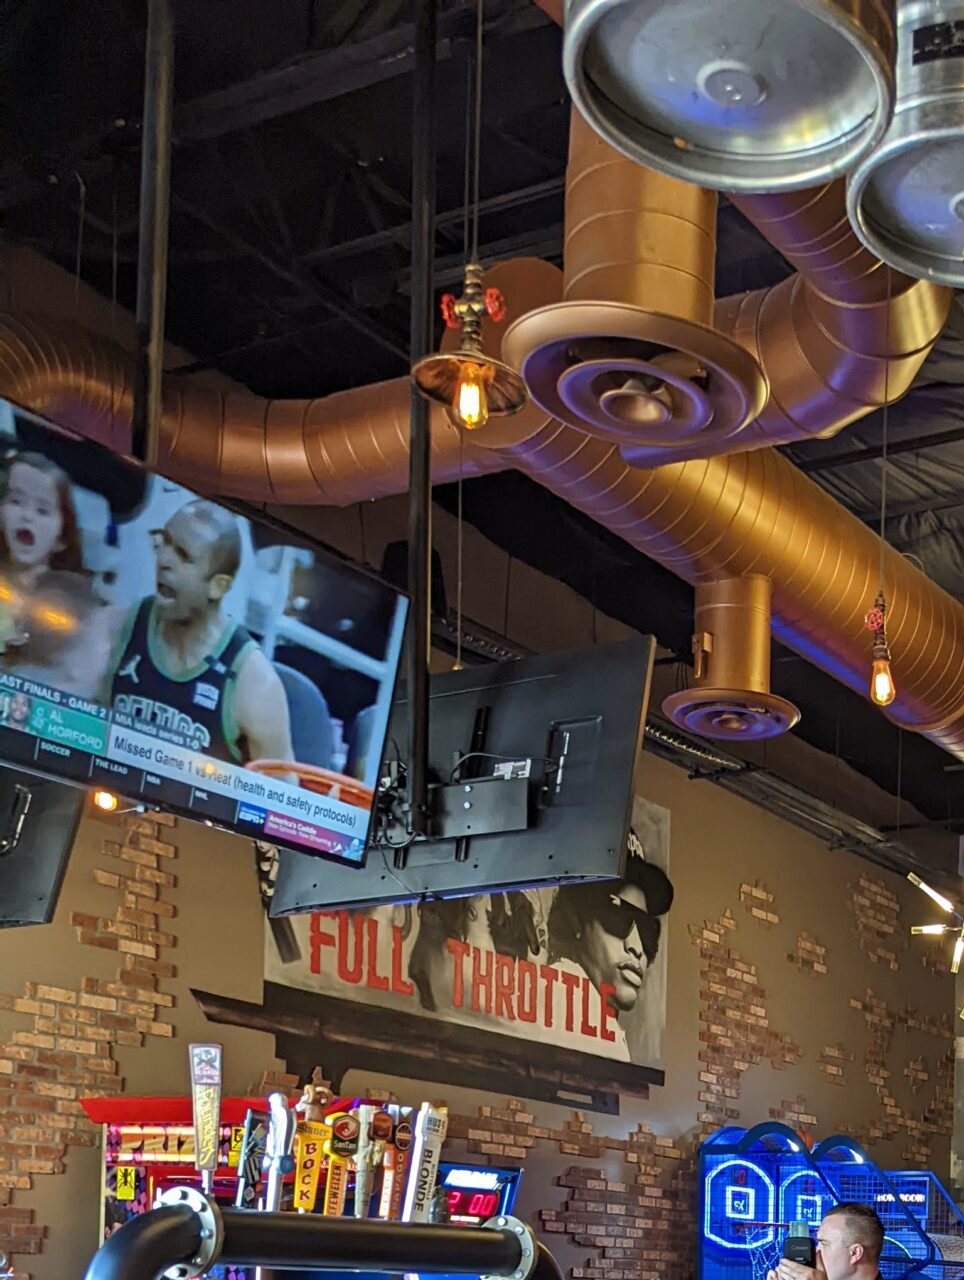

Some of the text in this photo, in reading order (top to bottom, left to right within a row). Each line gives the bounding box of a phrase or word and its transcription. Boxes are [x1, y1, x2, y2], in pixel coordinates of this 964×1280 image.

[0, 673, 20, 690] AST
[24, 682, 62, 703] FINALS
[69, 696, 98, 715] GAME
[99, 708, 107, 721] 2
[50, 709, 64, 723] AL
[40, 741, 72, 758] SOCCER
[48, 724, 103, 750] HORFORD
[115, 712, 201, 750] MIA leads series 1-0
[114, 734, 153, 760] Missed
[154, 748, 185, 772] Game
[188, 761, 193, 774] 1
[234, 773, 266, 798] (health
[267, 788, 286, 805] and
[286, 796, 314, 816] safety
[313, 804, 357, 829] protocols)
[309, 911, 617, 1043] FULL THROTTLE
[299, 1142, 318, 1201] BOCK
[414, 1148, 434, 1212] BLONDE
